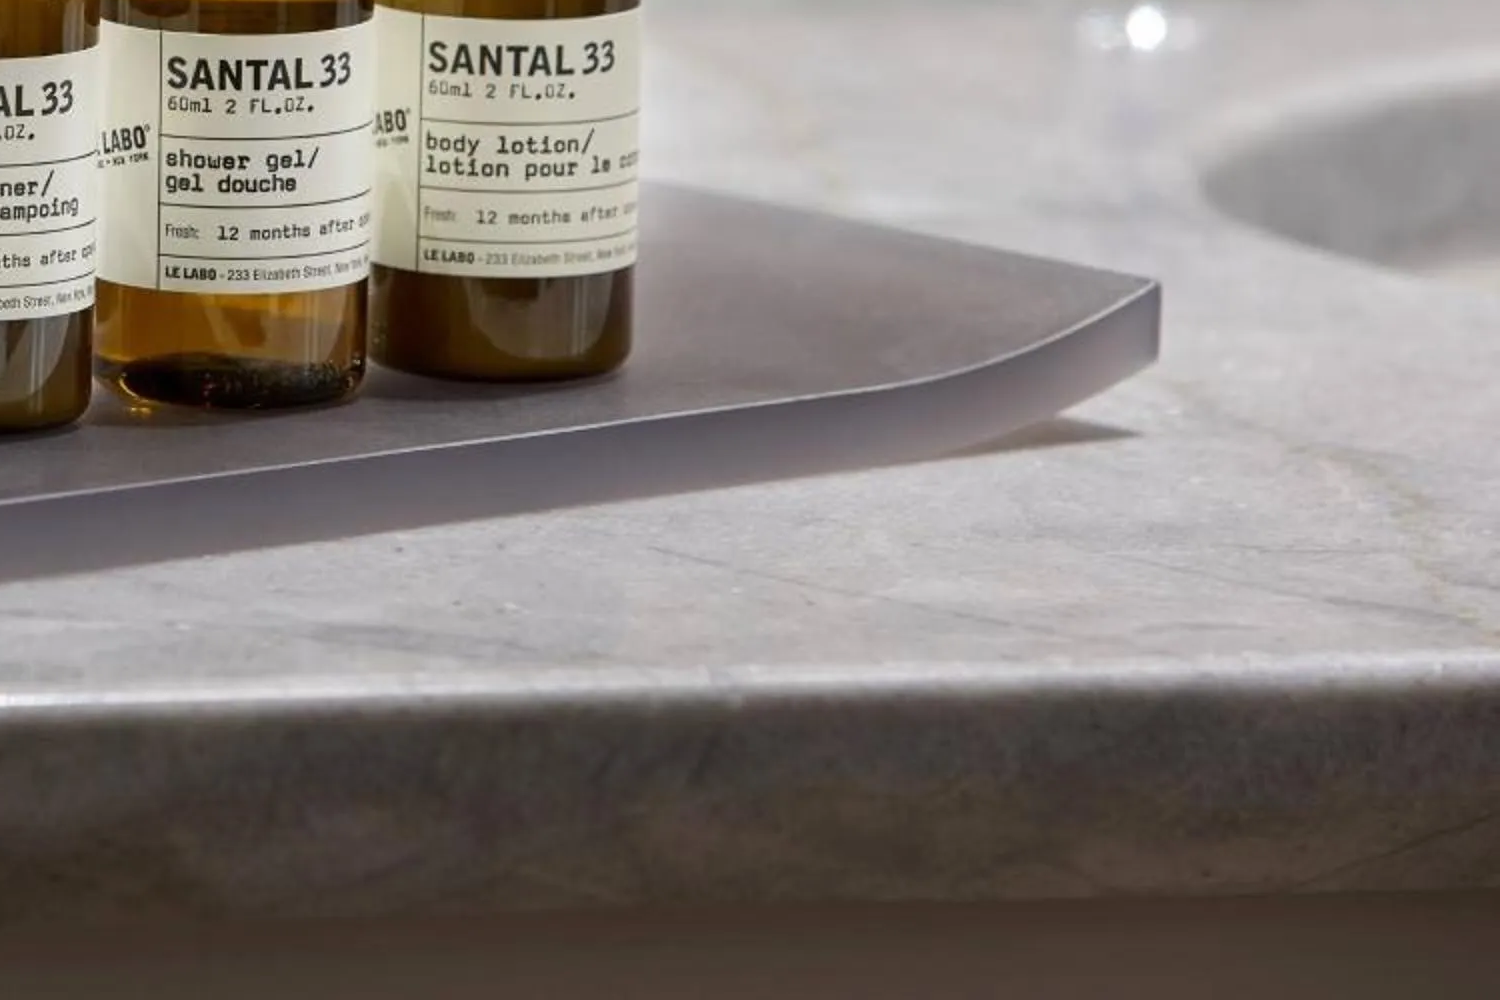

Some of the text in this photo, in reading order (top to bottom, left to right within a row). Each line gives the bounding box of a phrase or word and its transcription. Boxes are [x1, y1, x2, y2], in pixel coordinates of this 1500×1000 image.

[428, 39, 615, 77] SANTAL 33
[167, 51, 351, 91] SANTAL 33
[41, 79, 73, 116] 33
[428, 79, 472, 97] 60ml
[486, 84, 496, 99] 2
[167, 95, 212, 113] 60ml
[226, 99, 236, 114] 2
[426, 130, 480, 156] body
[497, 128, 595, 155] lotion/
[165, 147, 320, 172] shower gel/
[425, 156, 509, 178] lotion
[525, 161, 578, 181] pour
[591, 155, 610, 174] le
[165, 173, 297, 193] gel douche
[476, 209, 498, 225] 12
[508, 208, 571, 225] months
[580, 205, 618, 222] after
[217, 225, 239, 241] 12
[250, 224, 311, 241] months
[319, 218, 354, 236] after
[39, 248, 77, 266] after
[423, 249, 438, 261] LE
[441, 251, 475, 265] LABO
[165, 265, 180, 279] LE
[184, 267, 217, 281] LABO
[227, 269, 250, 281] 233
